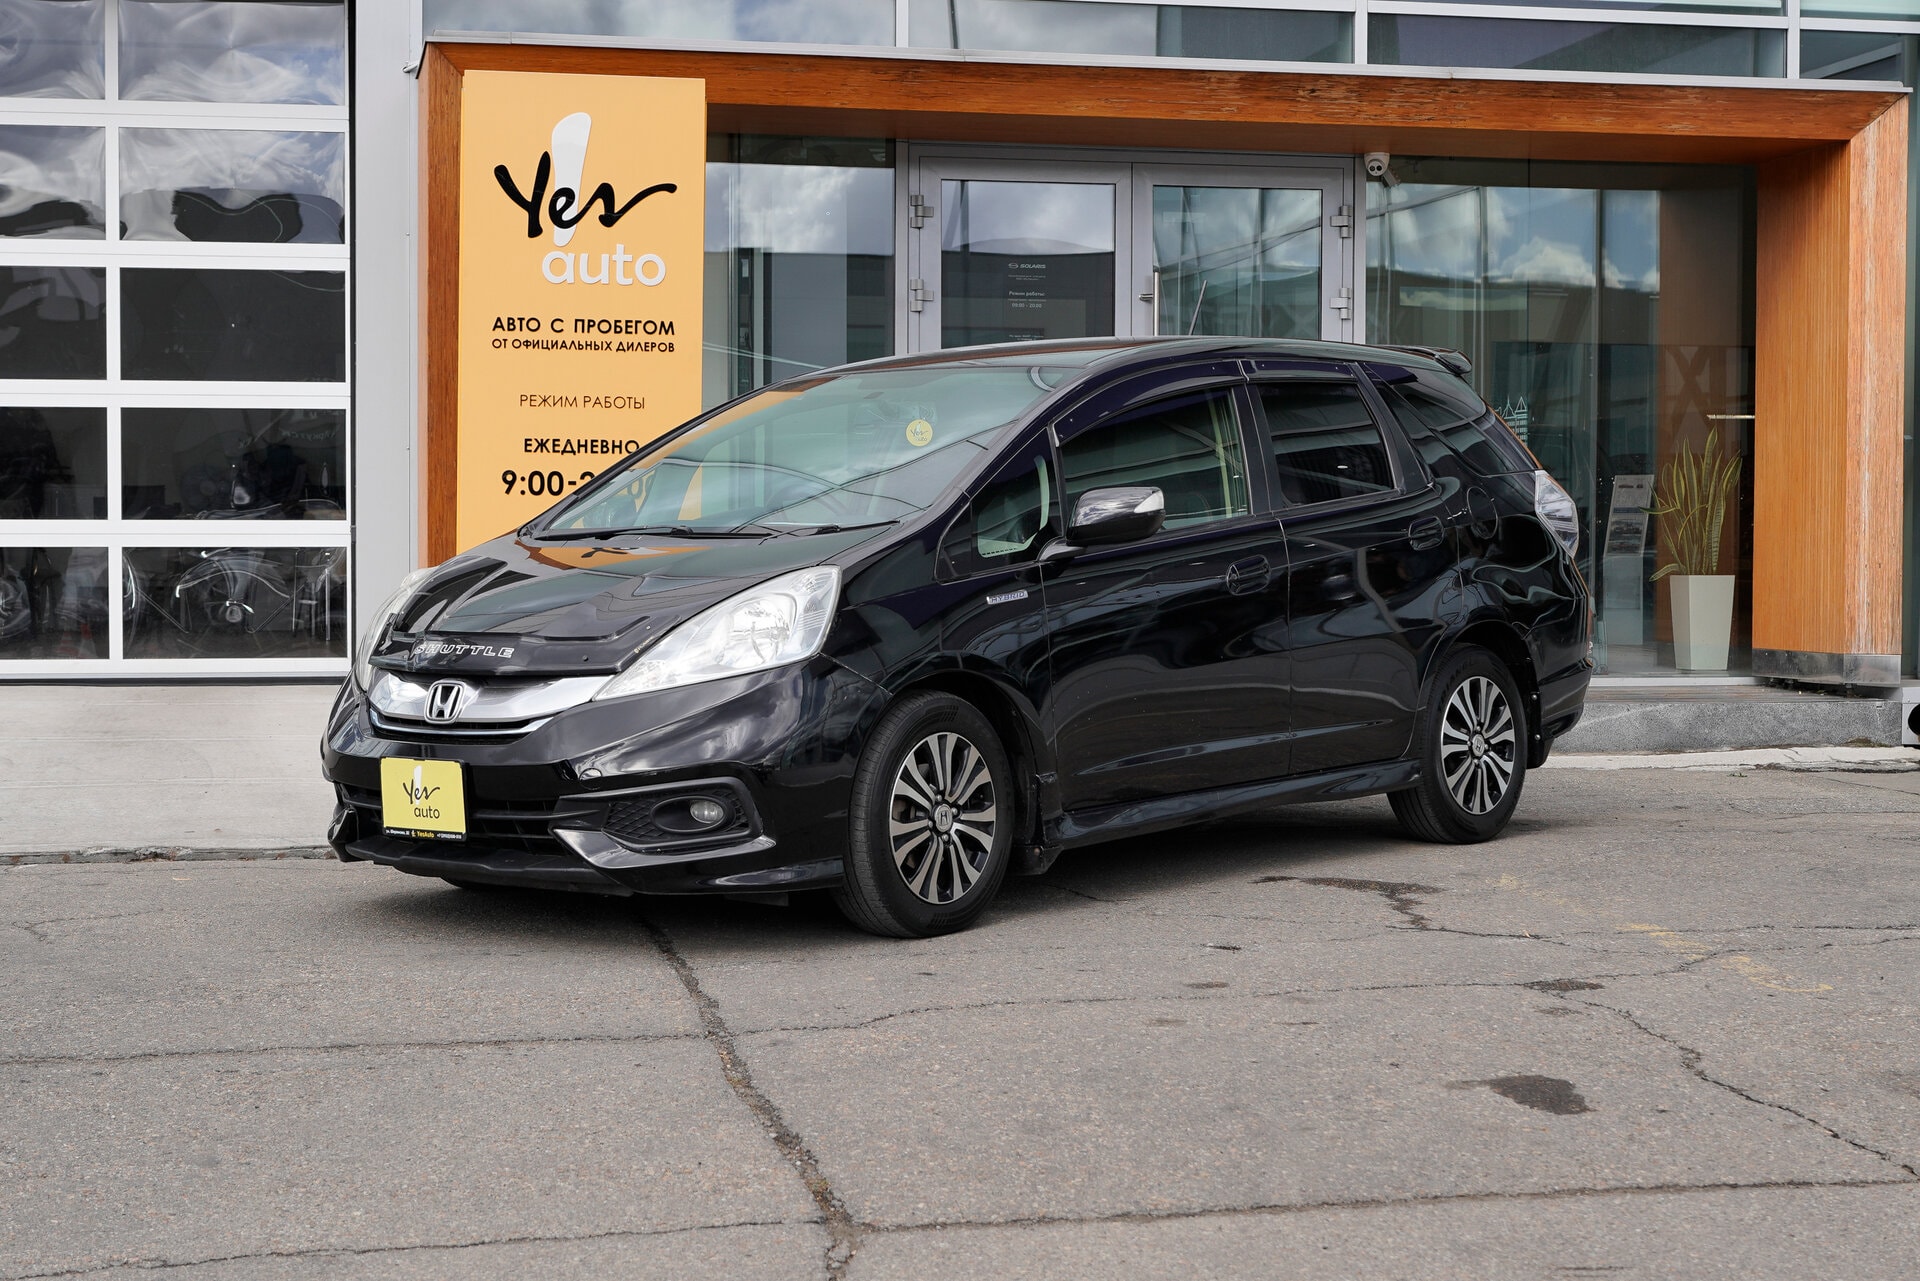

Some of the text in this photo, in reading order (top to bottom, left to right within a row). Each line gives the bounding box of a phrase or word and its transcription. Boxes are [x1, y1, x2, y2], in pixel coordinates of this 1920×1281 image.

[494, 150, 678, 238] Yes
[541, 243, 666, 286] auto
[492, 316, 675, 335] АВТО С ПРОБЕГОМ
[492, 338, 675, 353] ОТ ОФИЦИАЛЬНЫХ ДИЛЕРОВ
[519, 394, 645, 410] РЕЖИМ РАБОТЫ
[524, 438, 639, 455] ЕЖЕДНЕВНО
[990, 591, 1025, 603] HYBRID
[414, 642, 515, 658] SHUTTLE
[402, 779, 440, 805] Yes
[413, 806, 440, 819] auto
